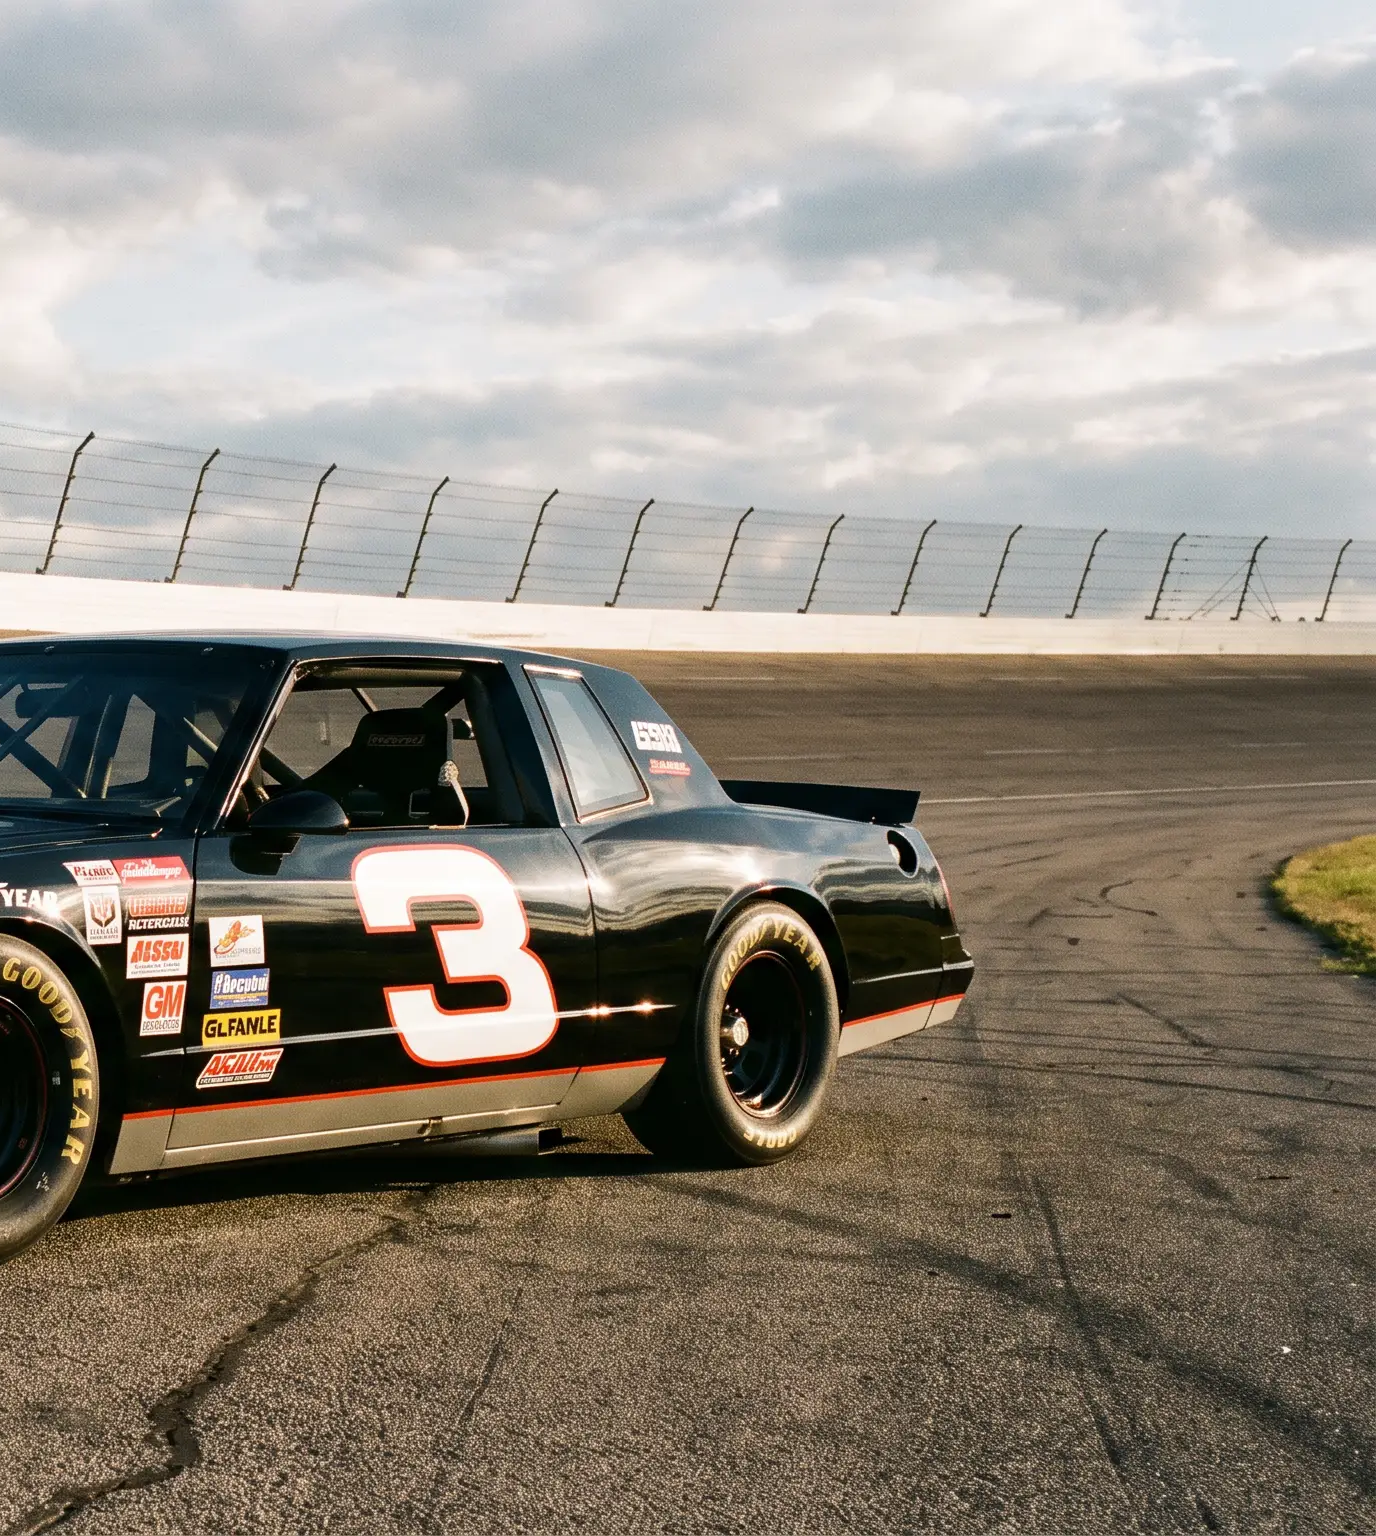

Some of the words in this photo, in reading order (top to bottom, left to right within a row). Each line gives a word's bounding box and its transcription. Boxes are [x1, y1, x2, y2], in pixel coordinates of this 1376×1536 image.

[350, 843, 560, 1068] 3
[145, 984, 185, 1020] GM
[204, 1015, 277, 1038] GLFANLE
